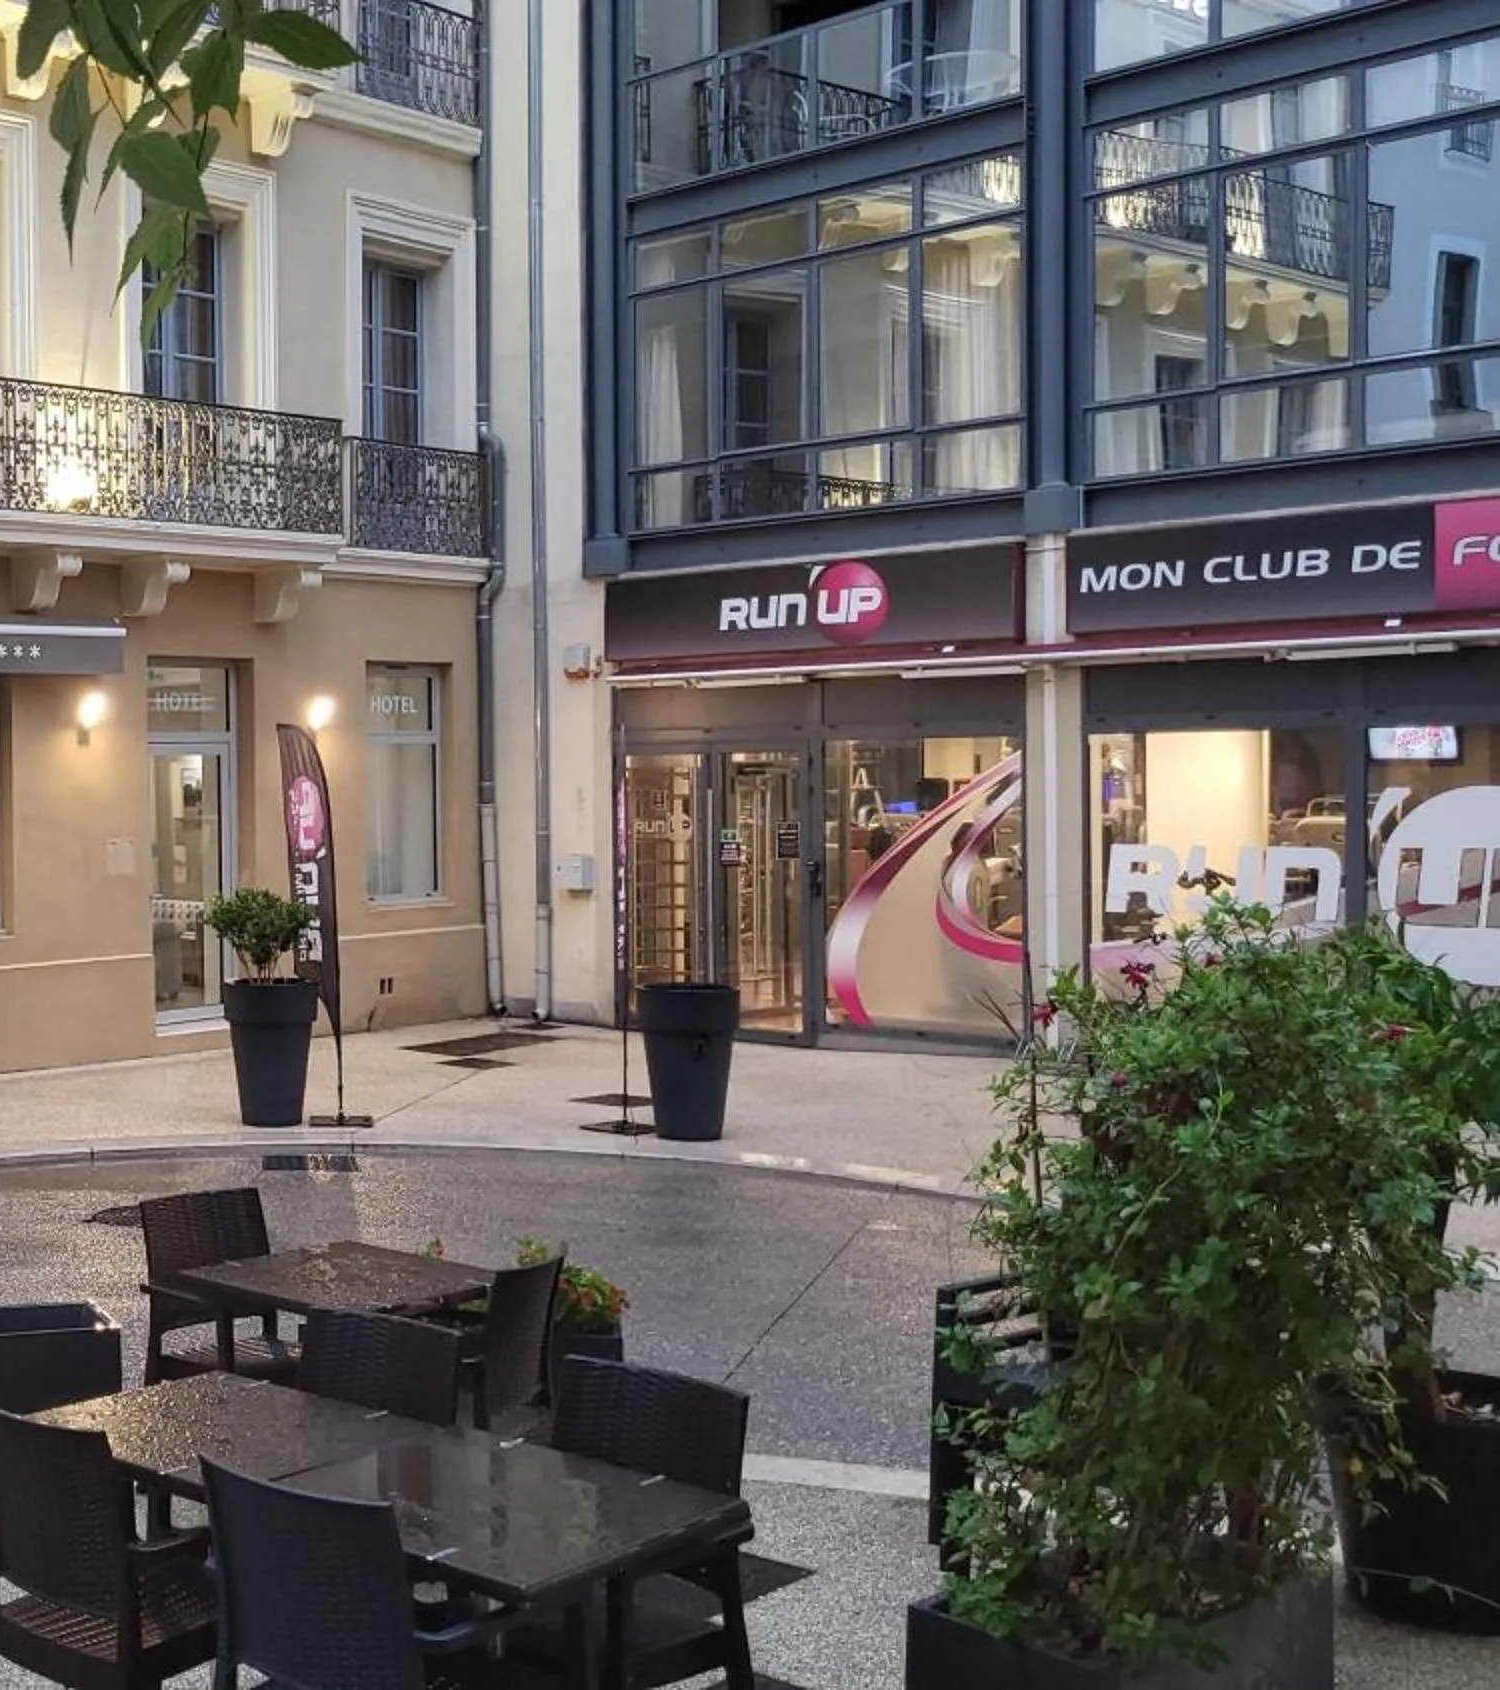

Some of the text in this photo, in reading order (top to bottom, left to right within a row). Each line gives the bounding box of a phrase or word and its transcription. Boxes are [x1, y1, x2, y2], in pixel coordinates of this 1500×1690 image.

[1079, 560, 1185, 594] MON
[1203, 548, 1330, 584] CLUB
[1351, 540, 1422, 573] DE
[370, 695, 418, 714] HOTEL
